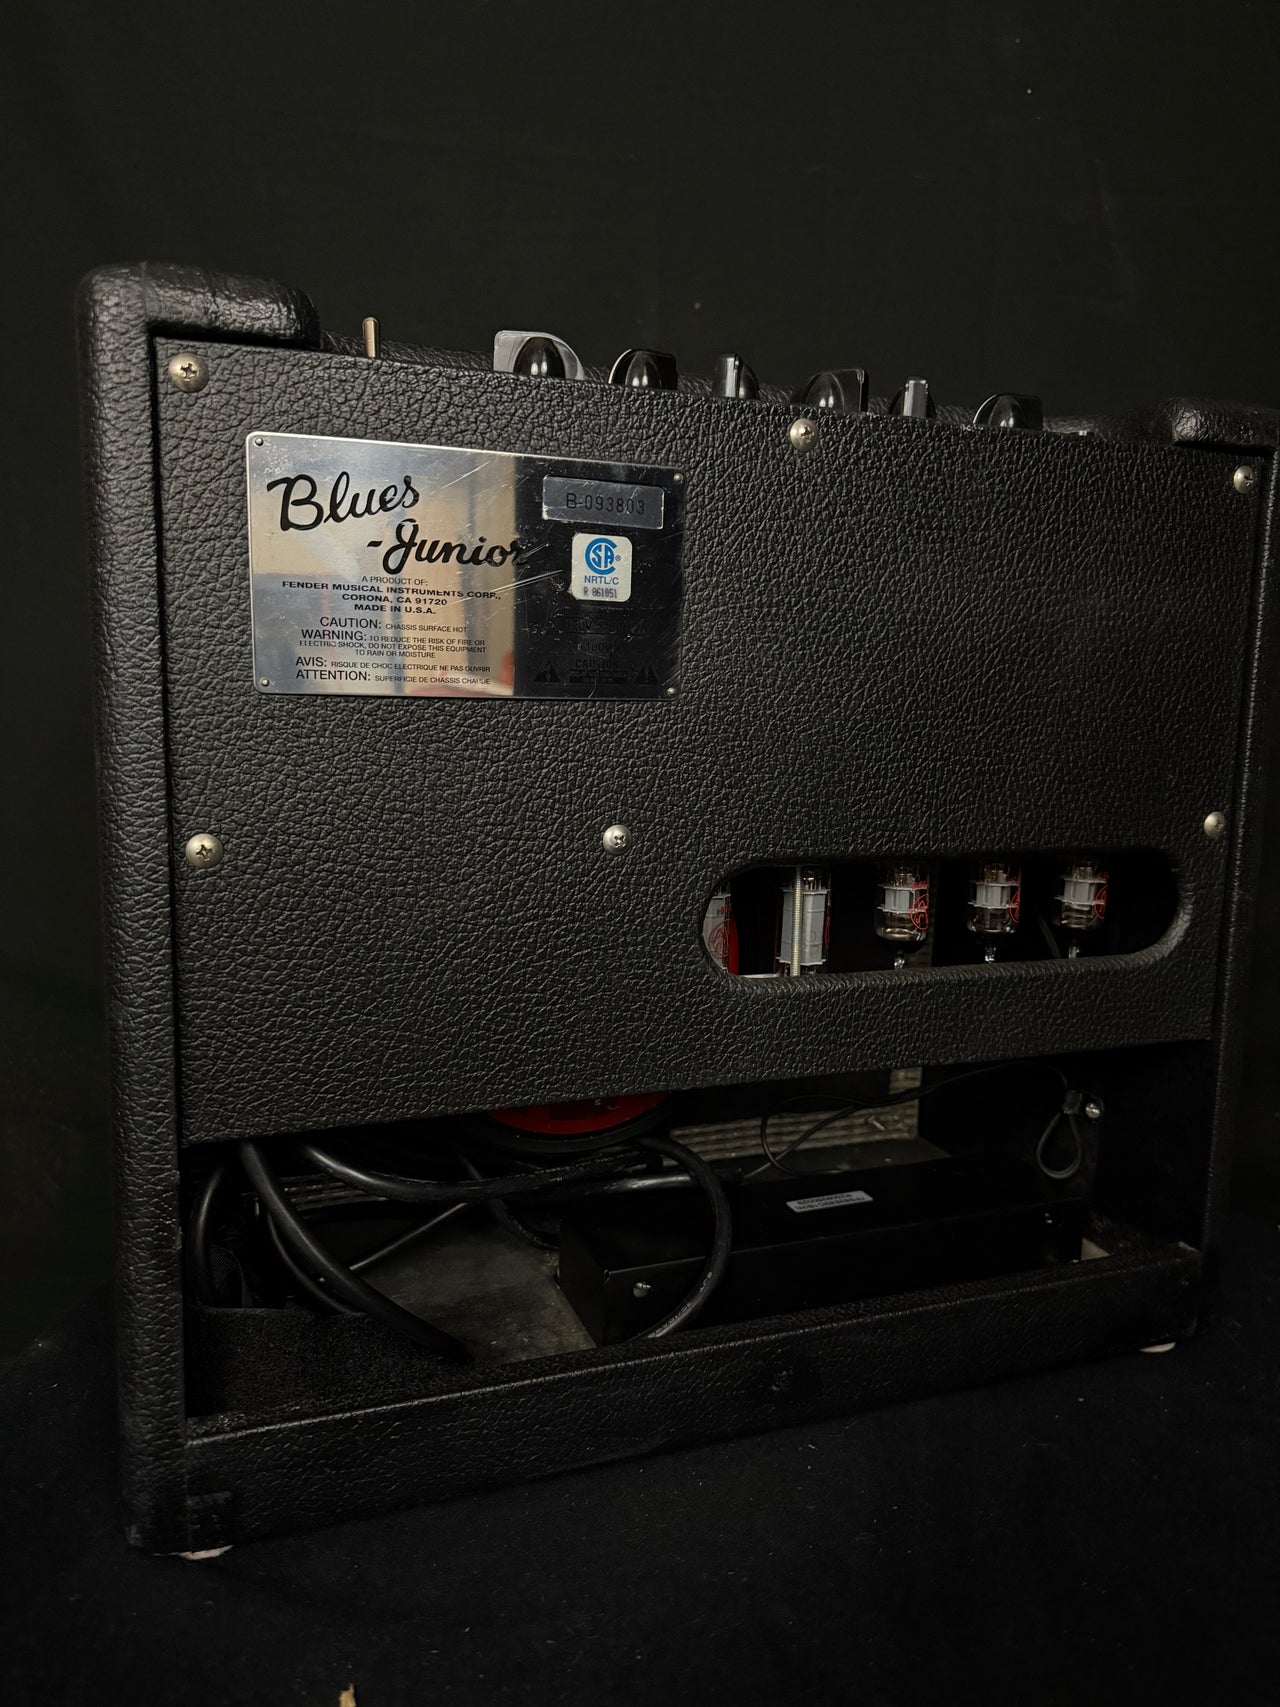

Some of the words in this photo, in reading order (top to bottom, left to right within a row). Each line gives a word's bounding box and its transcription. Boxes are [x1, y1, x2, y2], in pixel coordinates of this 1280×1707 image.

[266, 471, 419, 531] Blues
[566, 493, 645, 515] B-093803
[370, 576, 411, 585] PRODUCT
[584, 575, 619, 585] NRTL/C
[282, 580, 329, 590] FENDER
[332, 583, 383, 593] MUSICAL
[386, 586, 464, 597] INSTRUMENTS
[342, 593, 393, 603] CORONA,
[415, 597, 448, 606] 91720
[354, 604, 387, 612] MADE
[390, 605, 401, 613] IN
[405, 607, 436, 615] U.S.A.
[320, 616, 382, 629] CAUTION:
[386, 623, 417, 631] CHASSIS
[418, 624, 452, 633] SURFACE
[301, 629, 367, 641] WARNING:
[428, 637, 445, 645] RISK
[299, 640, 336, 648] ELECTRIC
[446, 645, 486, 653] EQUIPMENT
[295, 656, 327, 667] AVIS:
[331, 661, 358, 669] RISQUE
[371, 662, 393, 670] CHOC
[394, 663, 438, 671] ELECTRIQUE
[450, 664, 464, 672] PAS
[295, 669, 371, 681] ATTENTION:
[430, 676, 460, 684] CHASSIS
